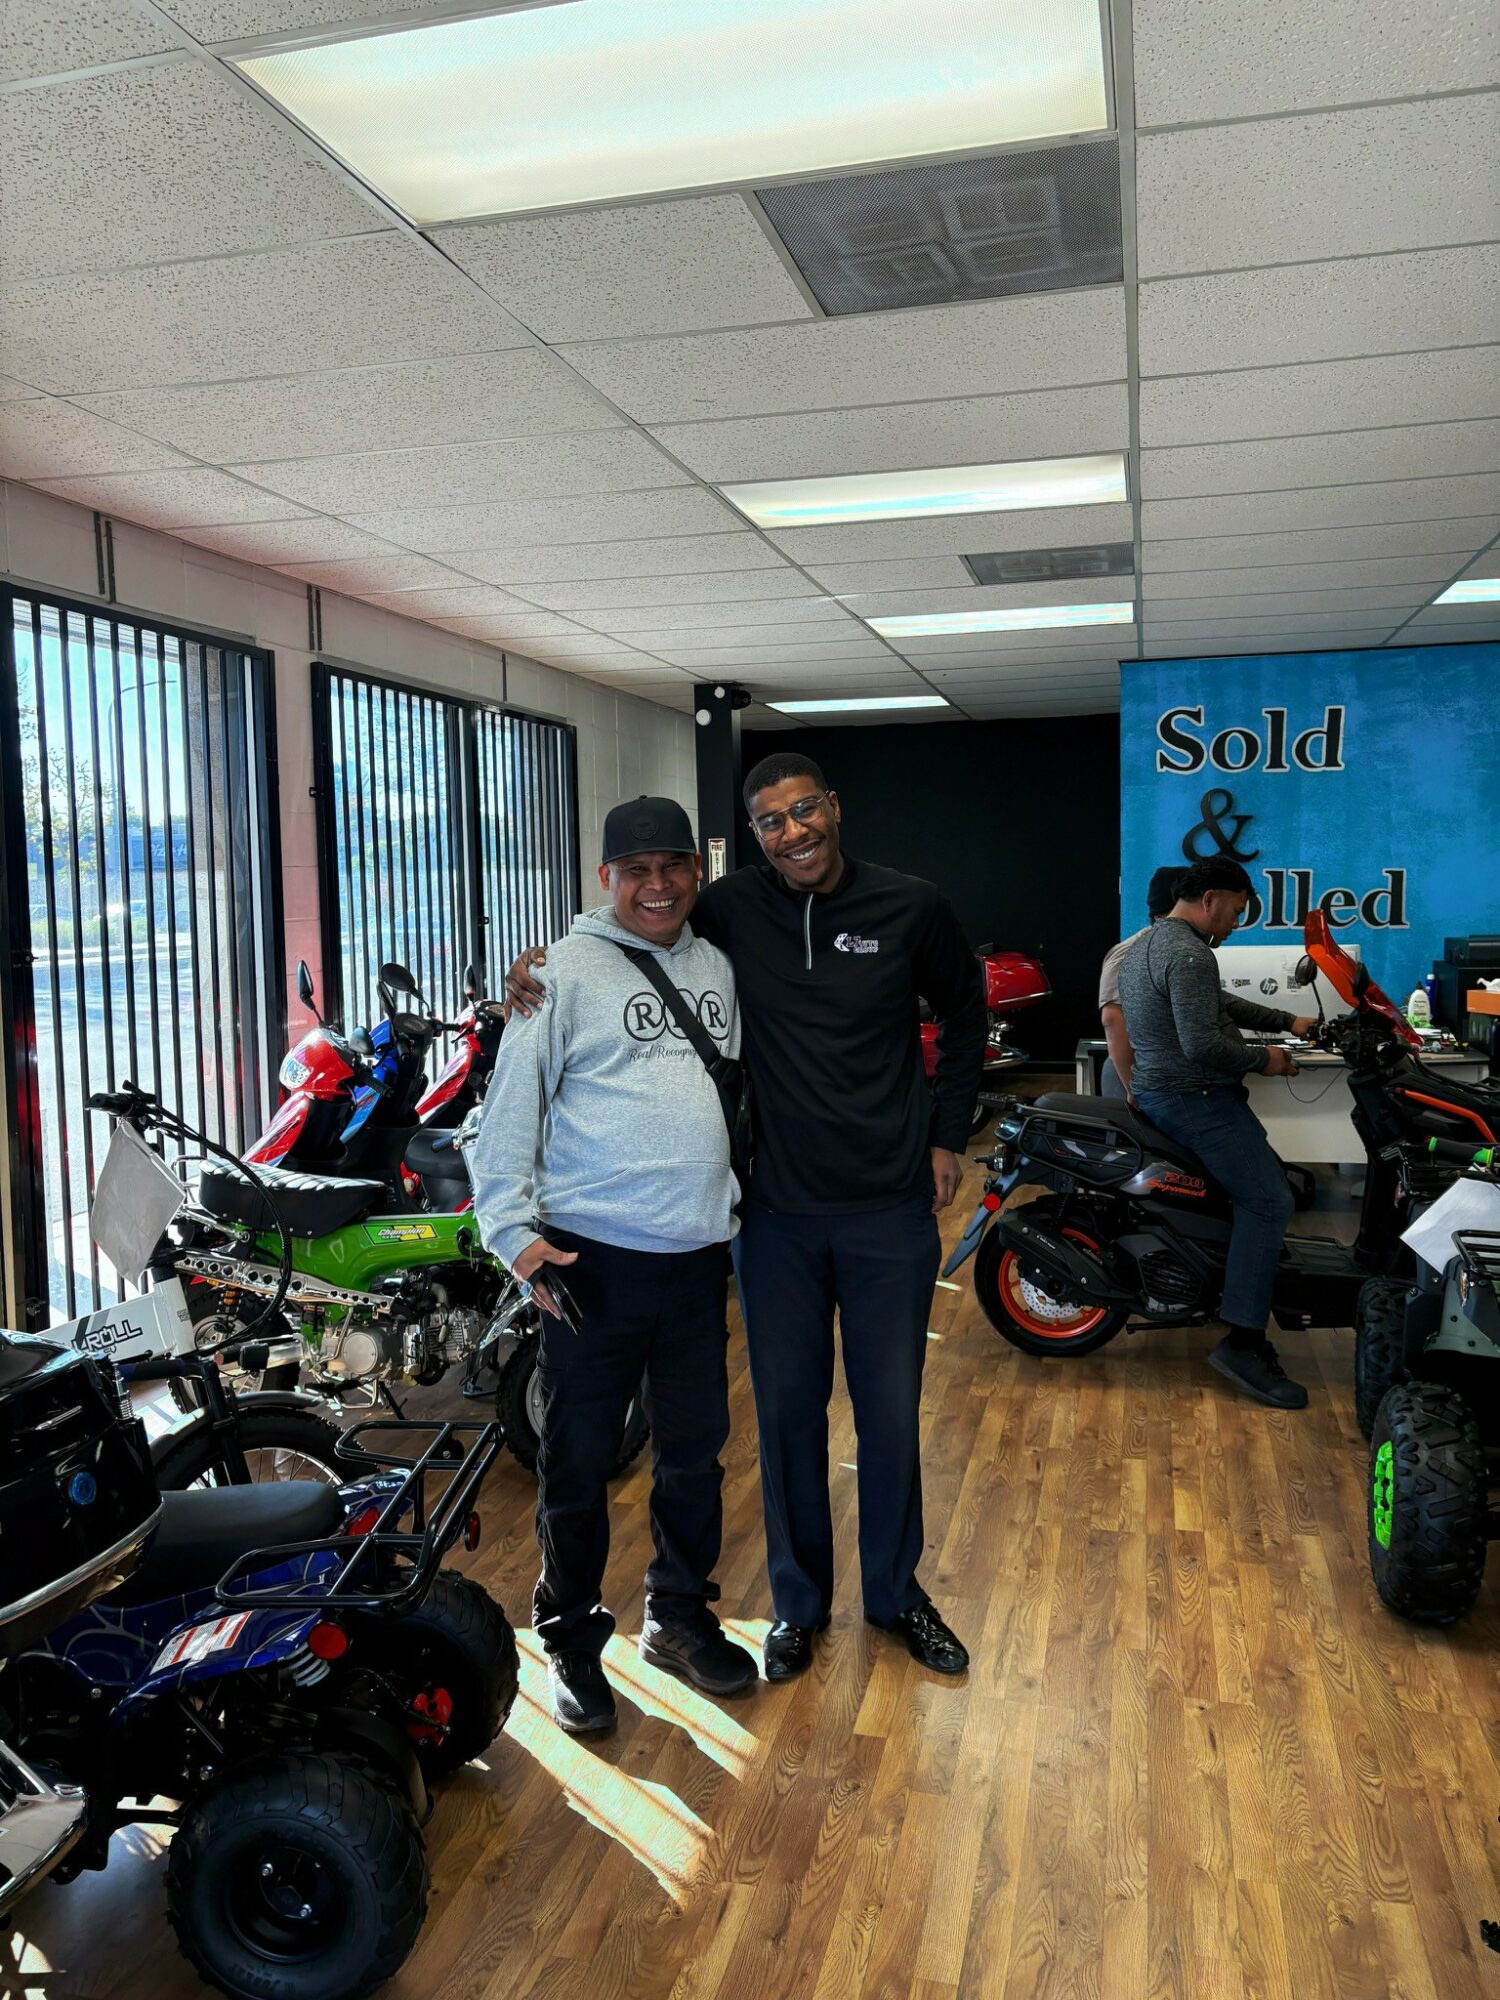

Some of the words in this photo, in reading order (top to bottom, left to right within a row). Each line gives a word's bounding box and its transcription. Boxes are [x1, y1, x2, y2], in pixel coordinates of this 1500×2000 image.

[1156, 705, 1345, 775] Sold
[1181, 787, 1260, 863] &
[1232, 868, 1410, 931] olled
[1260, 977, 1279, 996] hp
[628, 1044, 654, 1063] Real
